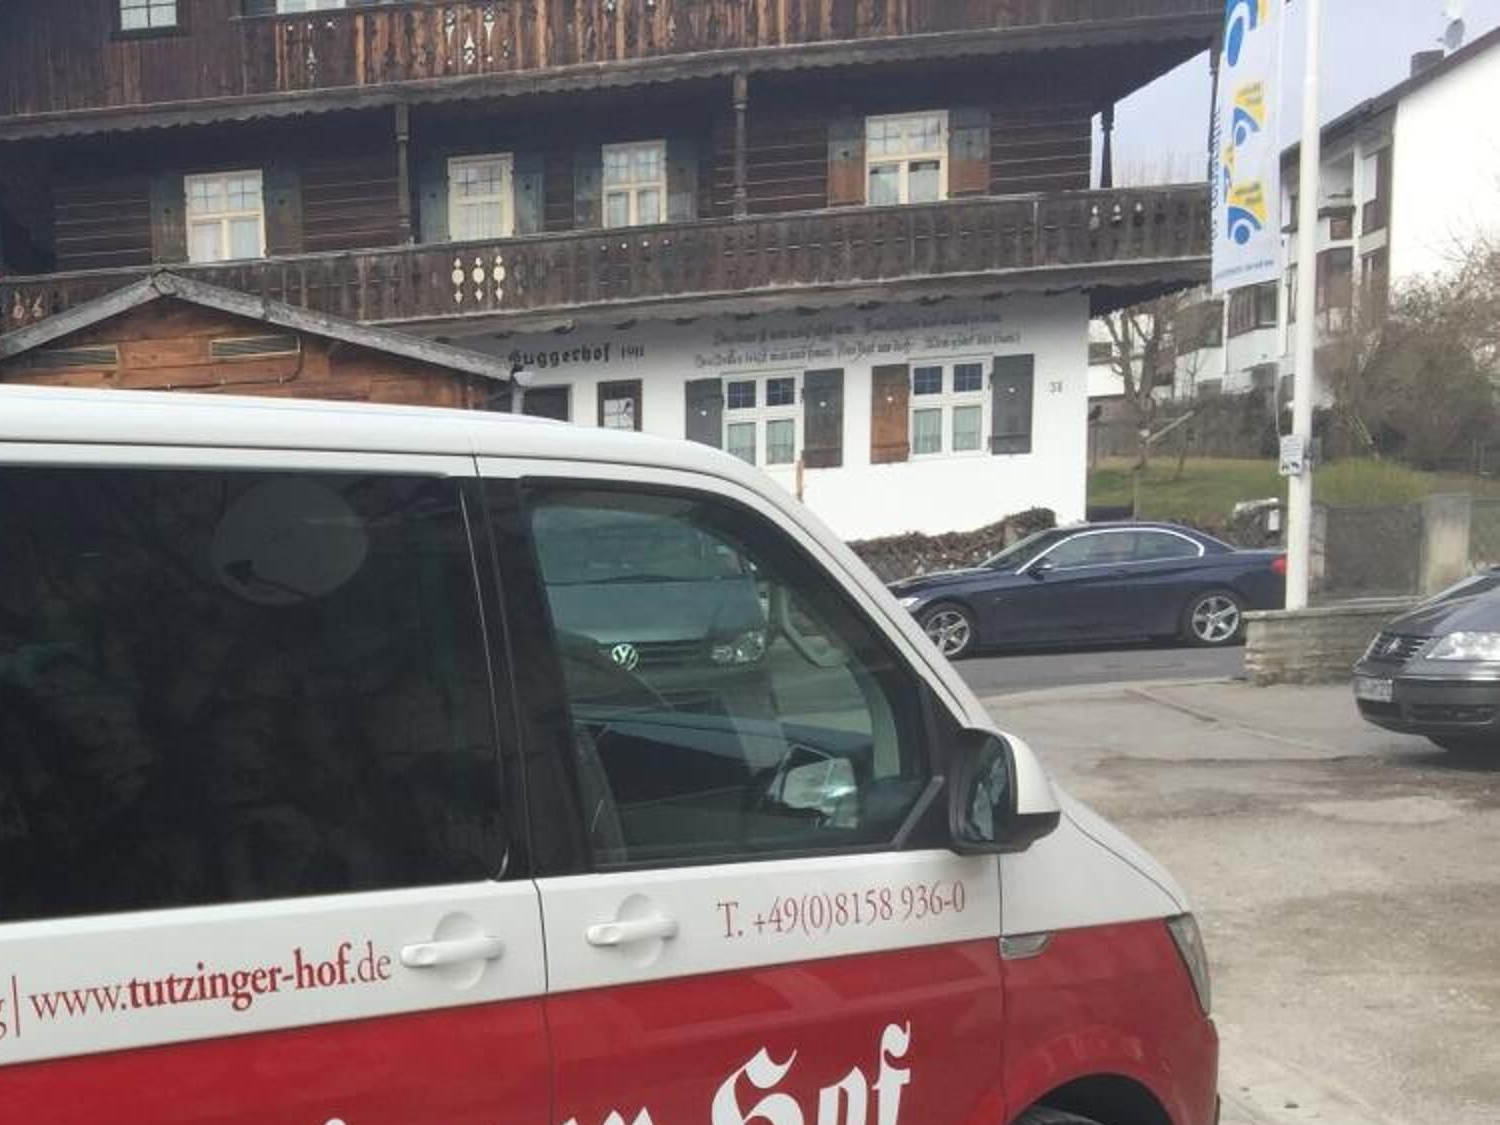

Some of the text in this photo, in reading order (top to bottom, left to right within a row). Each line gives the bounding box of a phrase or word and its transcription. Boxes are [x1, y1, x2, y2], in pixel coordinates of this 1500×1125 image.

[716, 879, 966, 938] T. +49(0)8158 936-0
[29, 941, 392, 1012] www.tutzinger-hof.de
